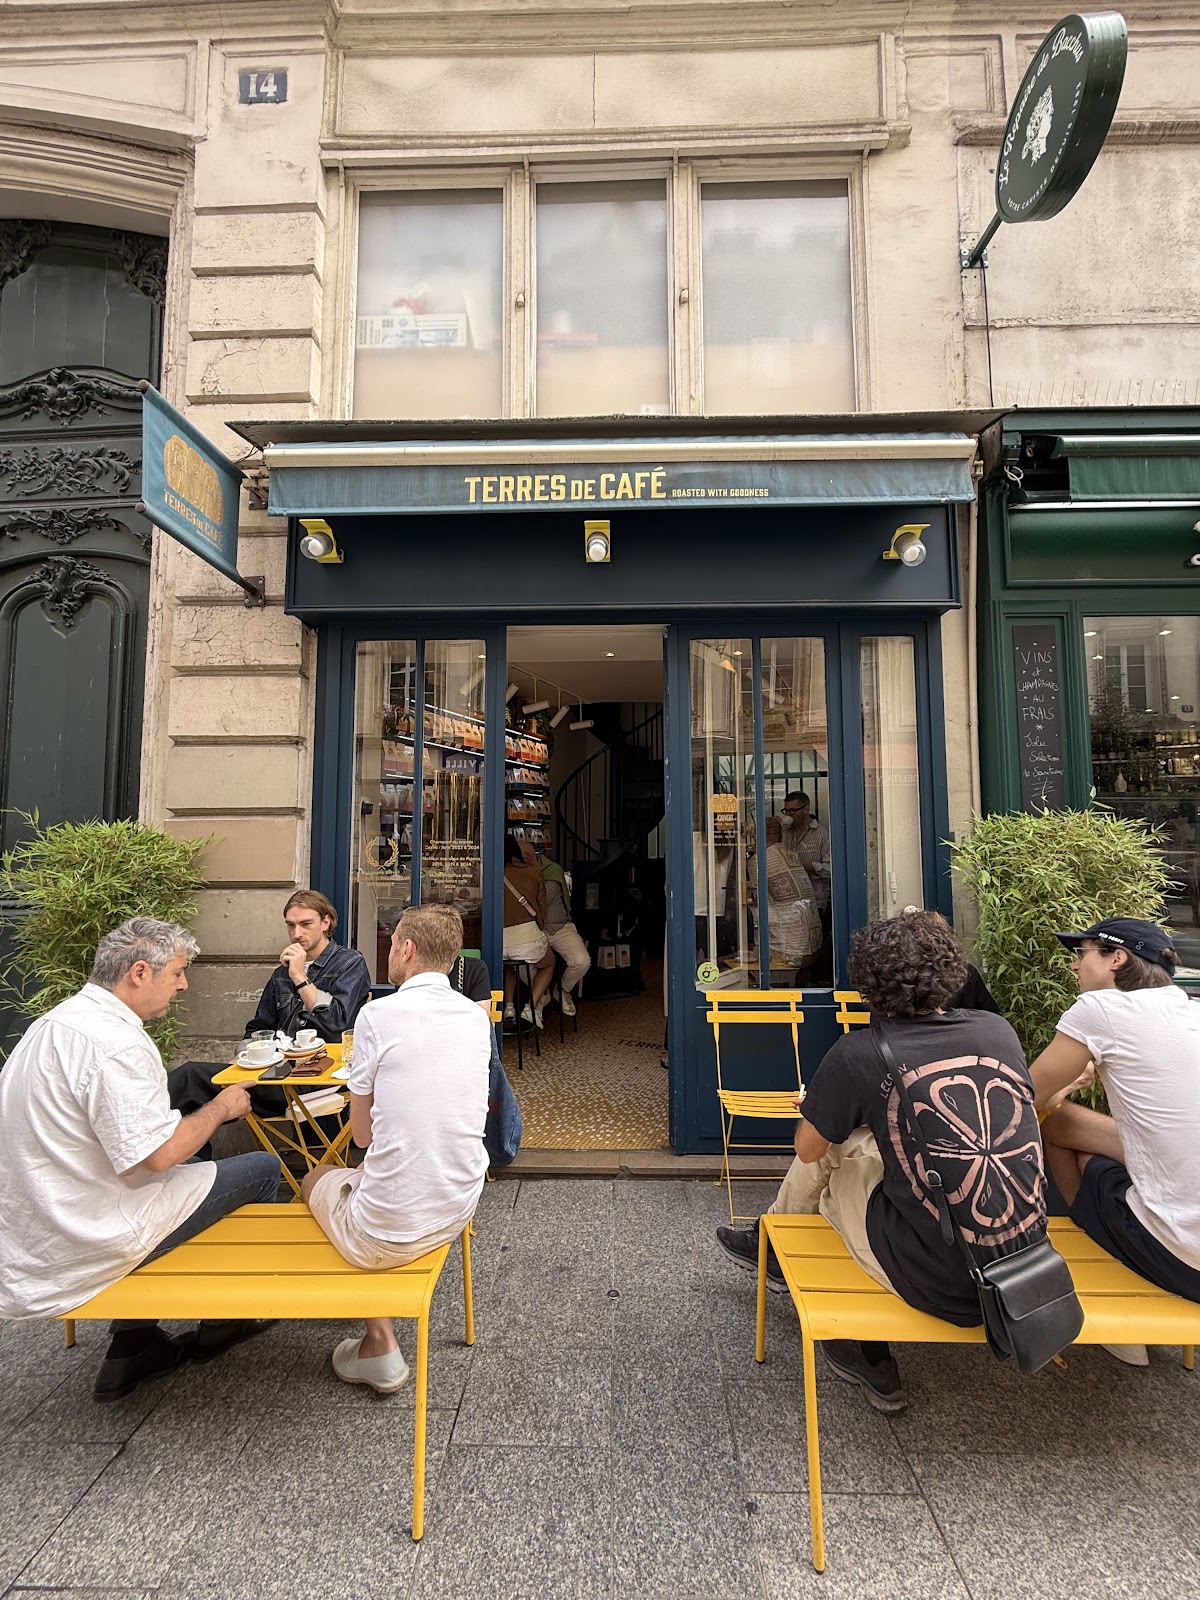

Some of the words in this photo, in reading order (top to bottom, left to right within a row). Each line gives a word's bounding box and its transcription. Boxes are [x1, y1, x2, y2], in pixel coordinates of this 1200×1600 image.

[1051, 27, 1084, 64] Bacchus
[1037, 52, 1050, 77] de
[249, 72, 277, 98] 14
[1003, 74, 1037, 157] Repaire
[999, 159, 1010, 191] Le
[1007, 197, 1021, 212] VOTRE
[1021, 176, 1049, 210] CAVISTE
[1049, 121, 1074, 174] DEPUIS
[464, 474, 567, 503] TERRES
[570, 479, 597, 500] DE
[600, 466, 667, 499] CAFÉ
[672, 488, 706, 498] ROASTED
[707, 488, 728, 497] WITH
[730, 488, 769, 497] GOODNESS
[164, 488, 197, 525] TERRES
[1021, 650, 1053, 666] VINS
[1017, 678, 1059, 692] CHAMPAGNES
[1031, 667, 1042, 677] et
[1033, 694, 1045, 703] AU
[1022, 706, 1055, 722] FRAIS
